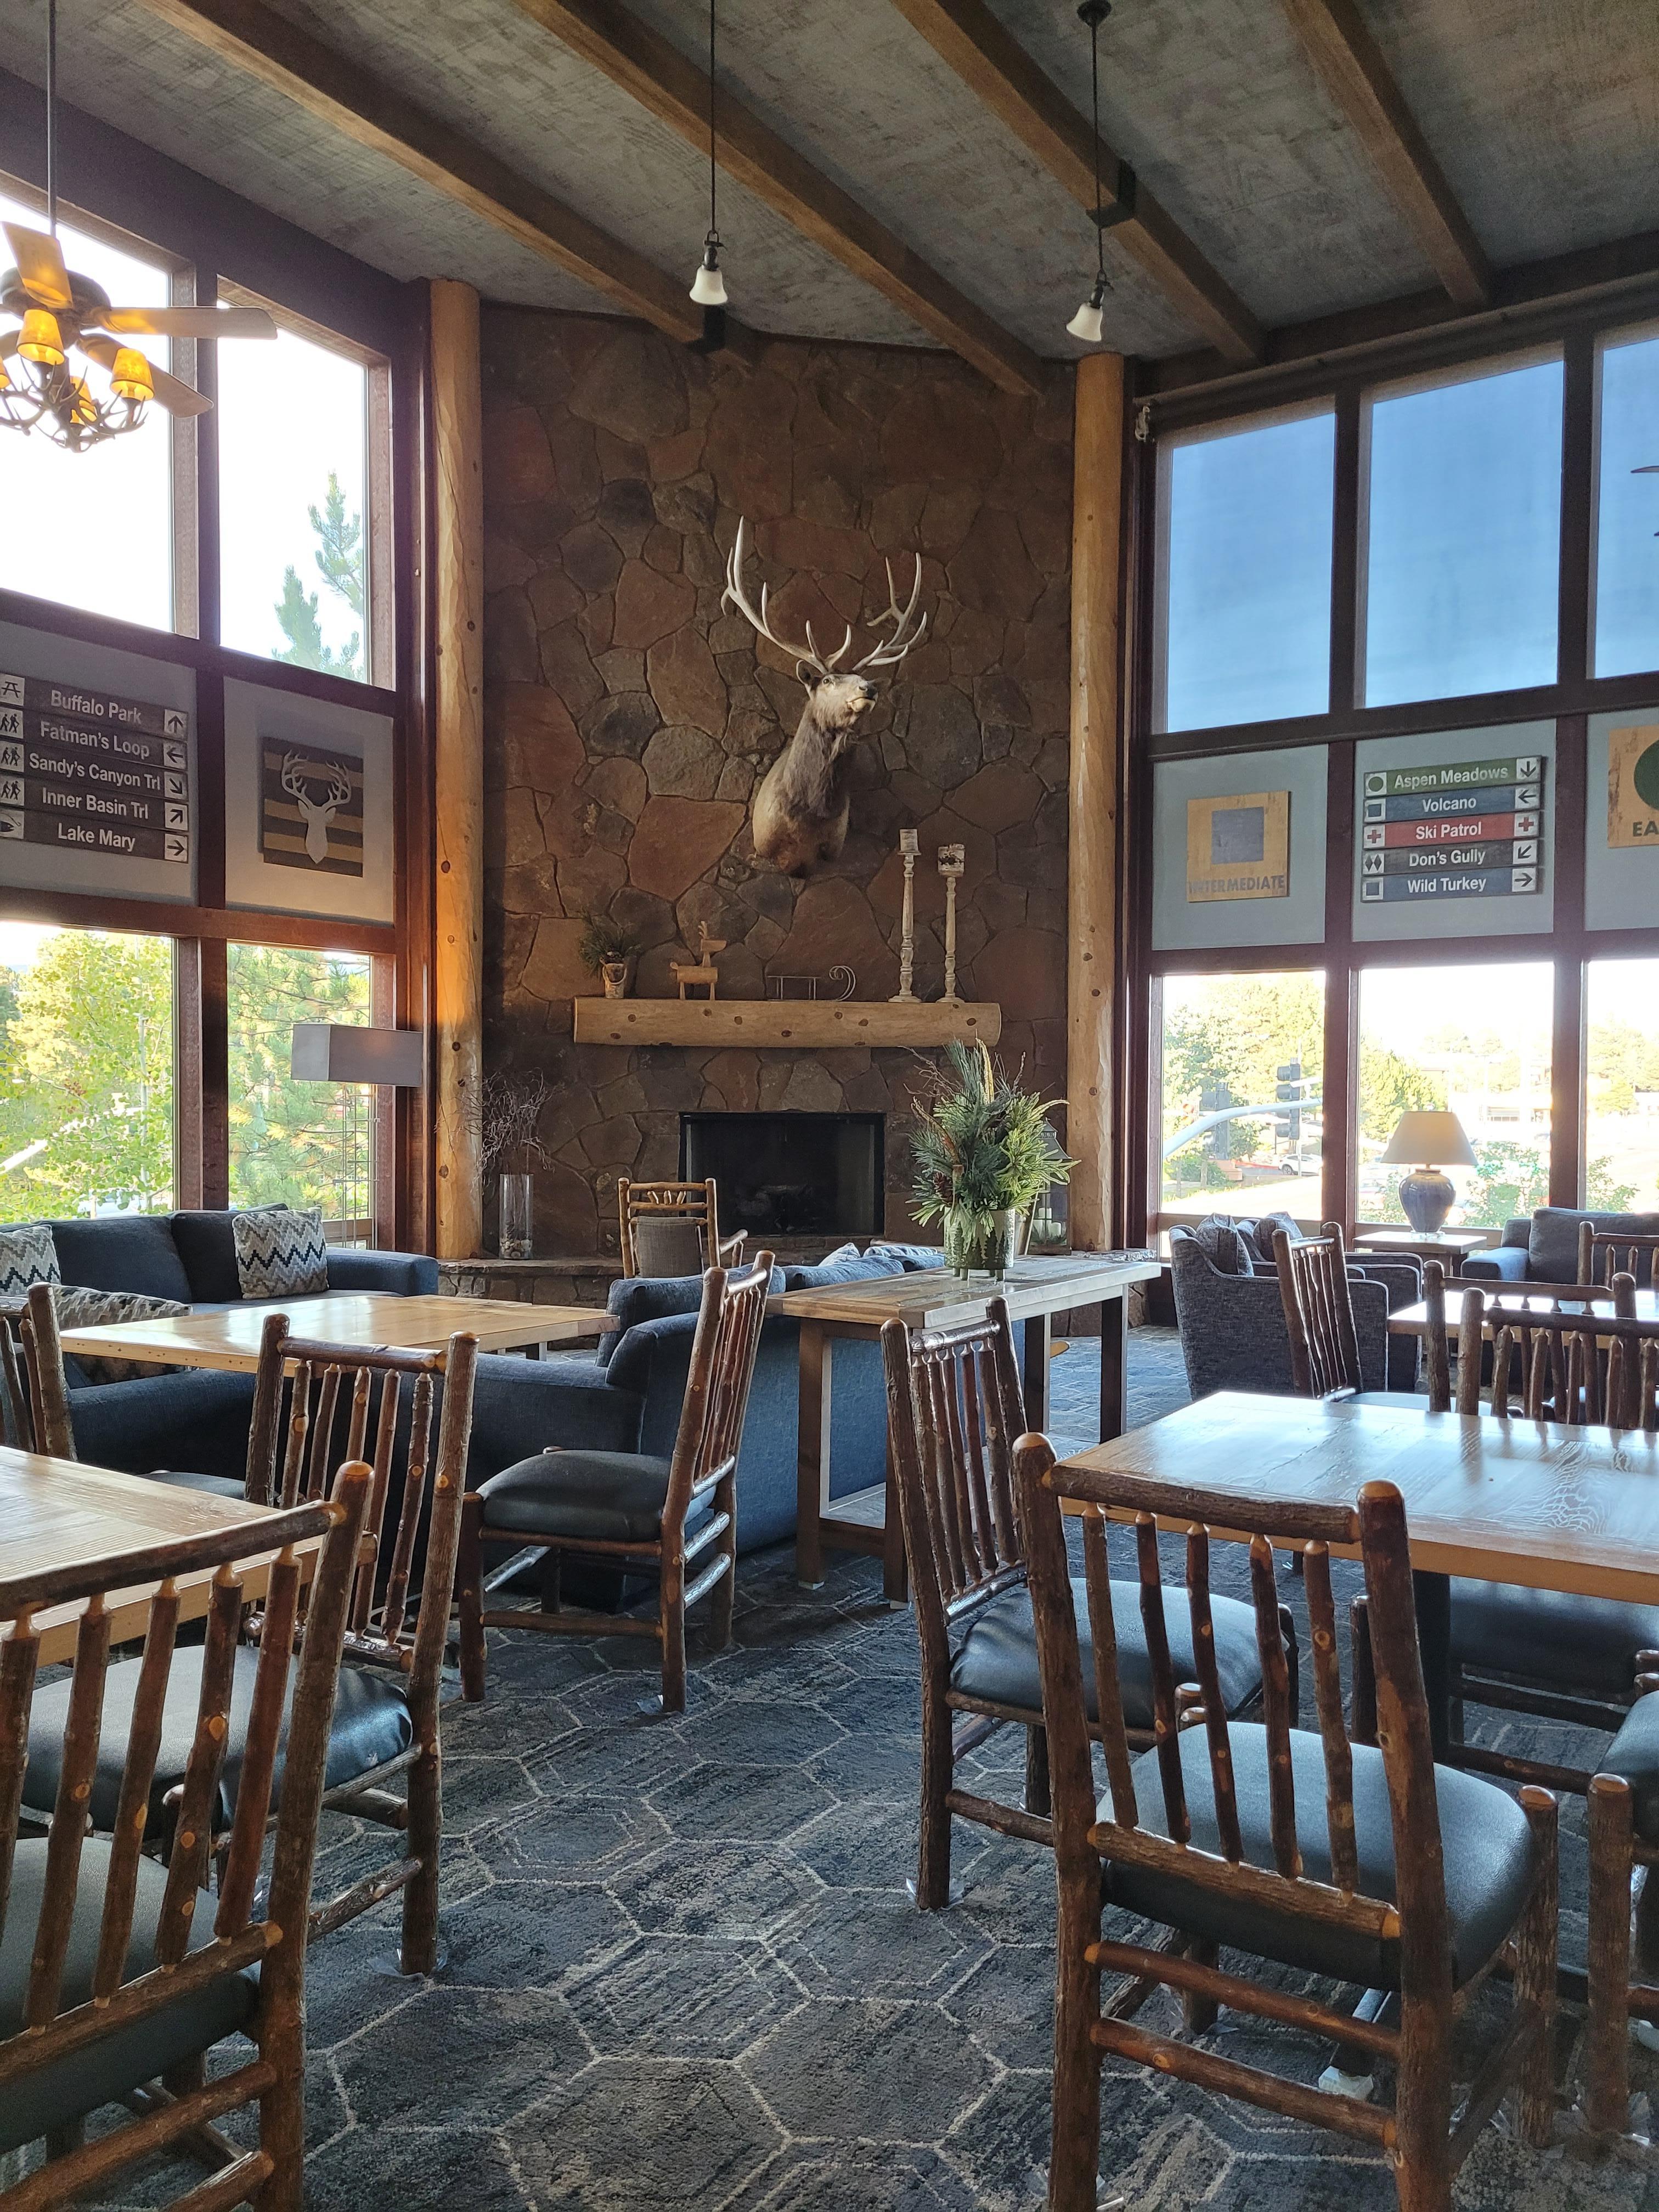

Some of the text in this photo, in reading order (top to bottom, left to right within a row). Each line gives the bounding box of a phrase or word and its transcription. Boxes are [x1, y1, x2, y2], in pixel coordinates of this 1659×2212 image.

[51, 690, 142, 725] Buffalo Park
[40, 720, 150, 759] Fatman's Loop
[29, 753, 161, 790] Sandy's Canyon Trl
[1394, 766, 1509, 790] Aspen Meadows
[42, 788, 148, 819] Inner Basin Trl
[1423, 798, 1477, 812] Volcano
[58, 823, 136, 852] Lake Mary
[1415, 821, 1482, 840] Ski Patrol
[1409, 849, 1486, 867] Don's Gully
[1407, 877, 1487, 893] Wild Turkey
